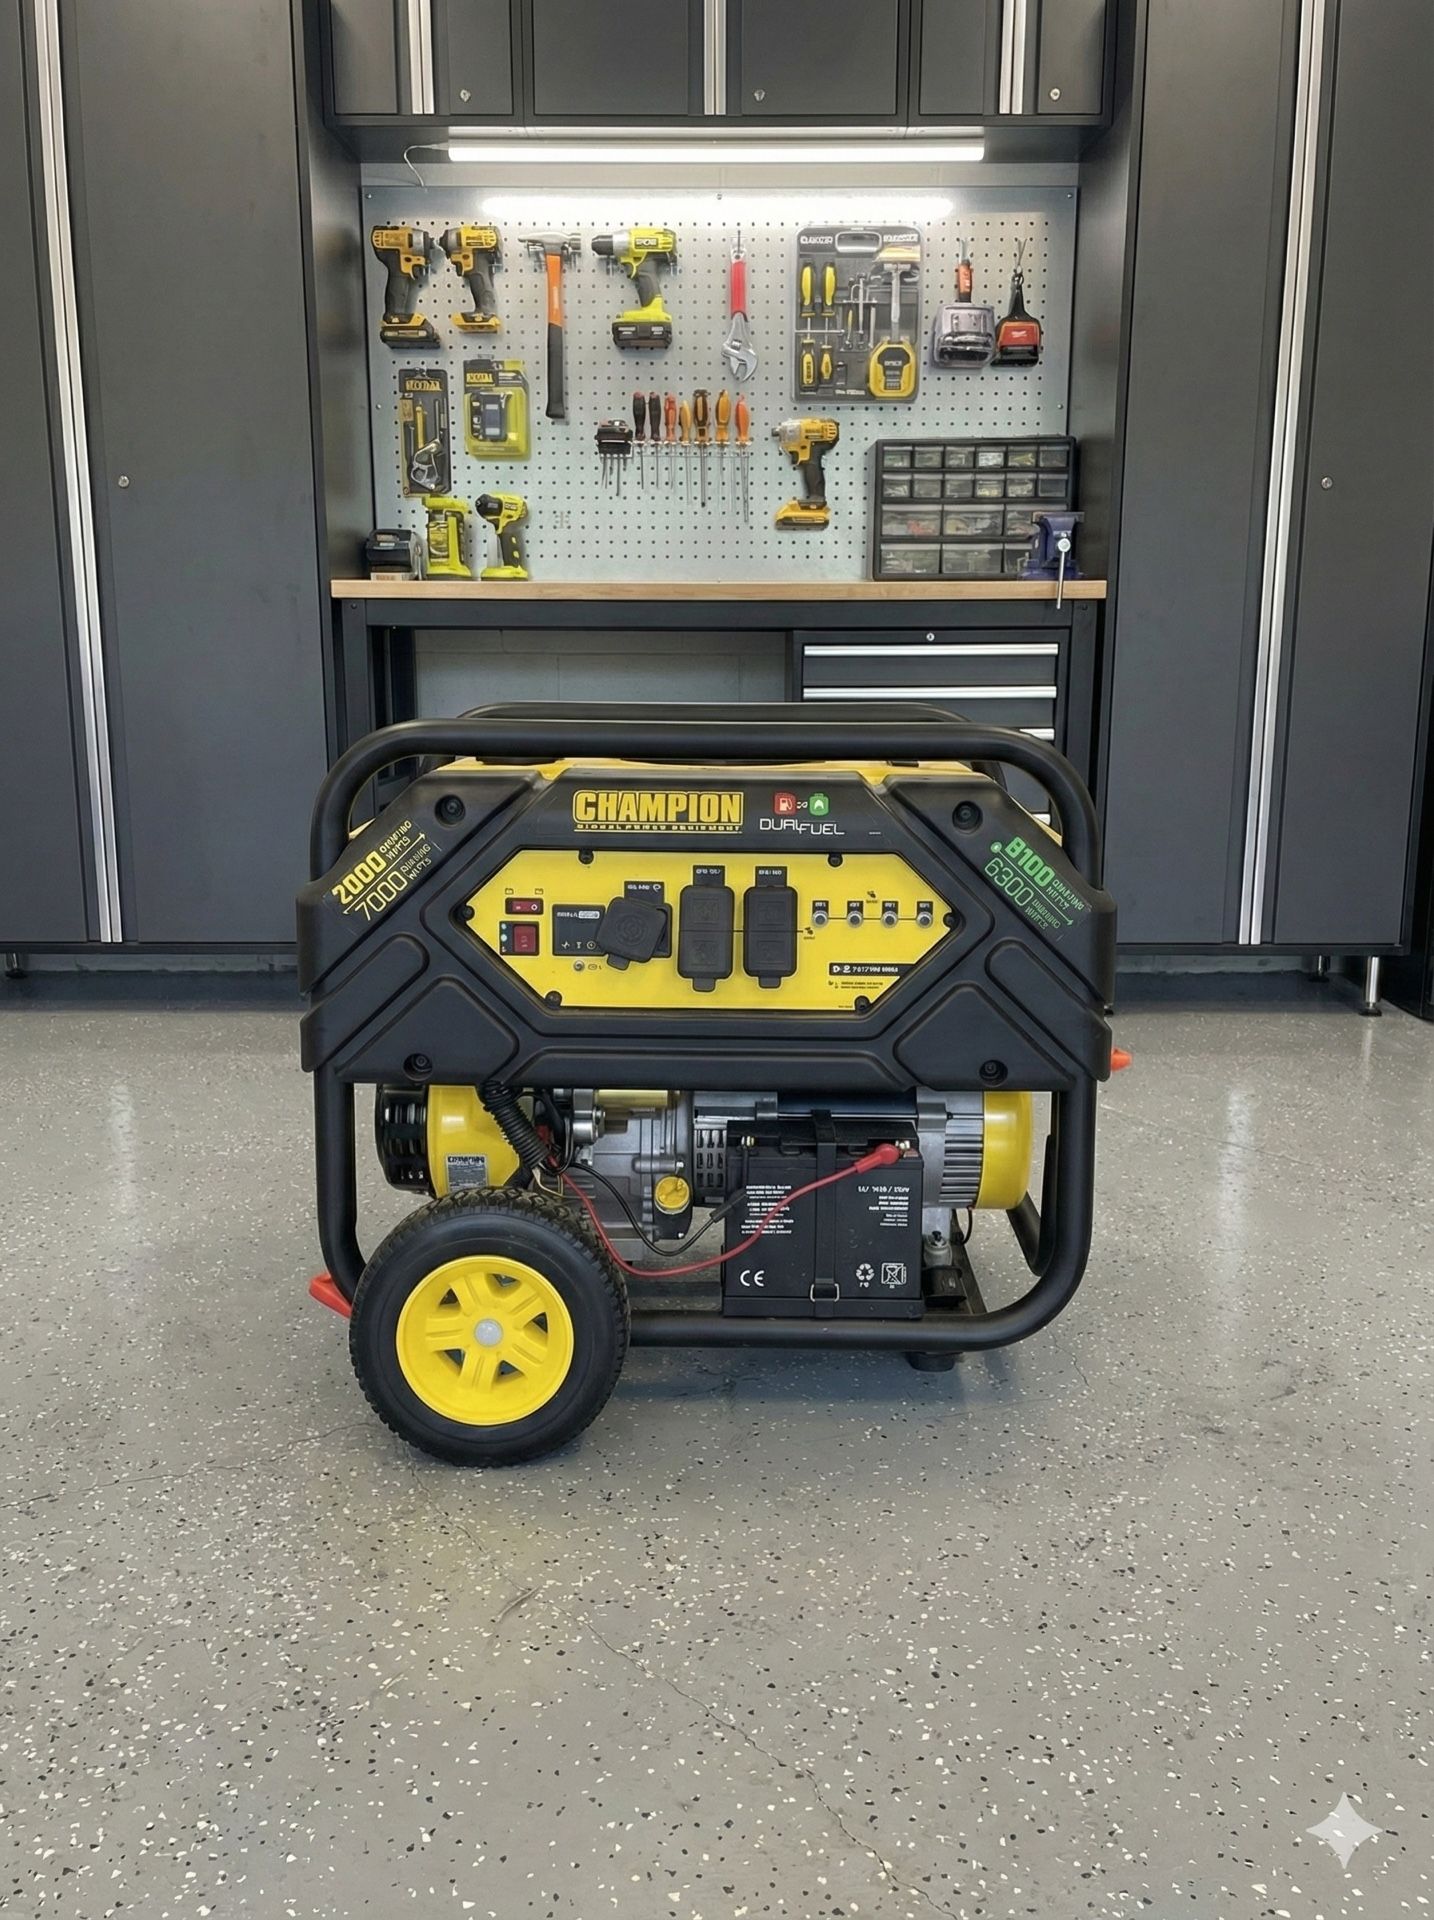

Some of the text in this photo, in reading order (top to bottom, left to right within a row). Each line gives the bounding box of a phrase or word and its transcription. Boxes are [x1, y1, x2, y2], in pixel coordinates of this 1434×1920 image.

[575, 791, 741, 823] CHAMPION
[331, 850, 387, 905] 2000
[354, 870, 408, 921] 7000
[984, 857, 1034, 906] 6300
